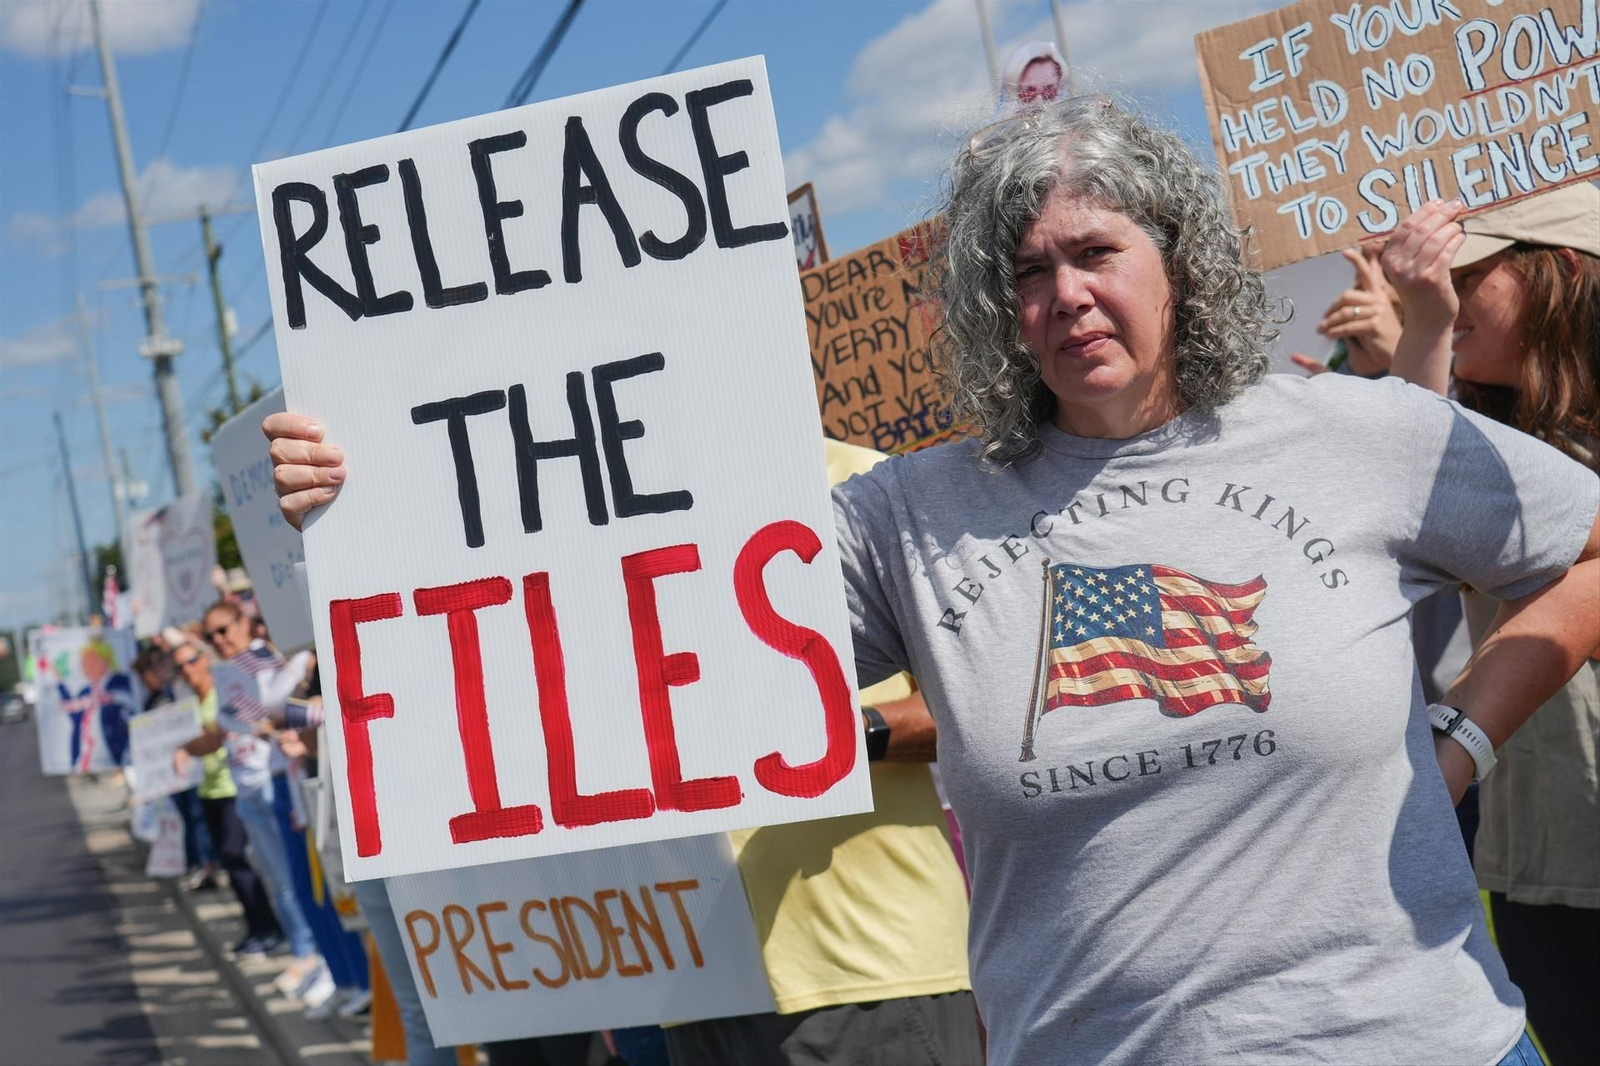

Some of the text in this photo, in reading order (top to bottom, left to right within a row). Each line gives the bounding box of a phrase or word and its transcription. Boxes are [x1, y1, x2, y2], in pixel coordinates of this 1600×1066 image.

[1221, 79, 1348, 153] HELD
[1362, 53, 1435, 110] NO
[1239, 22, 1313, 92] IF
[1229, 60, 1600, 200] THEY WOULDN'T
[272, 79, 788, 329] RELEASE
[1278, 191, 1348, 239] TO
[801, 250, 895, 303] DEAR
[810, 304, 911, 380] VERRY
[821, 364, 882, 417] And
[411, 352, 693, 548] THE
[937, 477, 1350, 636] REJECTING KINGS
[330, 520, 856, 857] FILES
[1020, 729, 1277, 798] SINCE 1776
[405, 879, 704, 998] PRESIDENT
